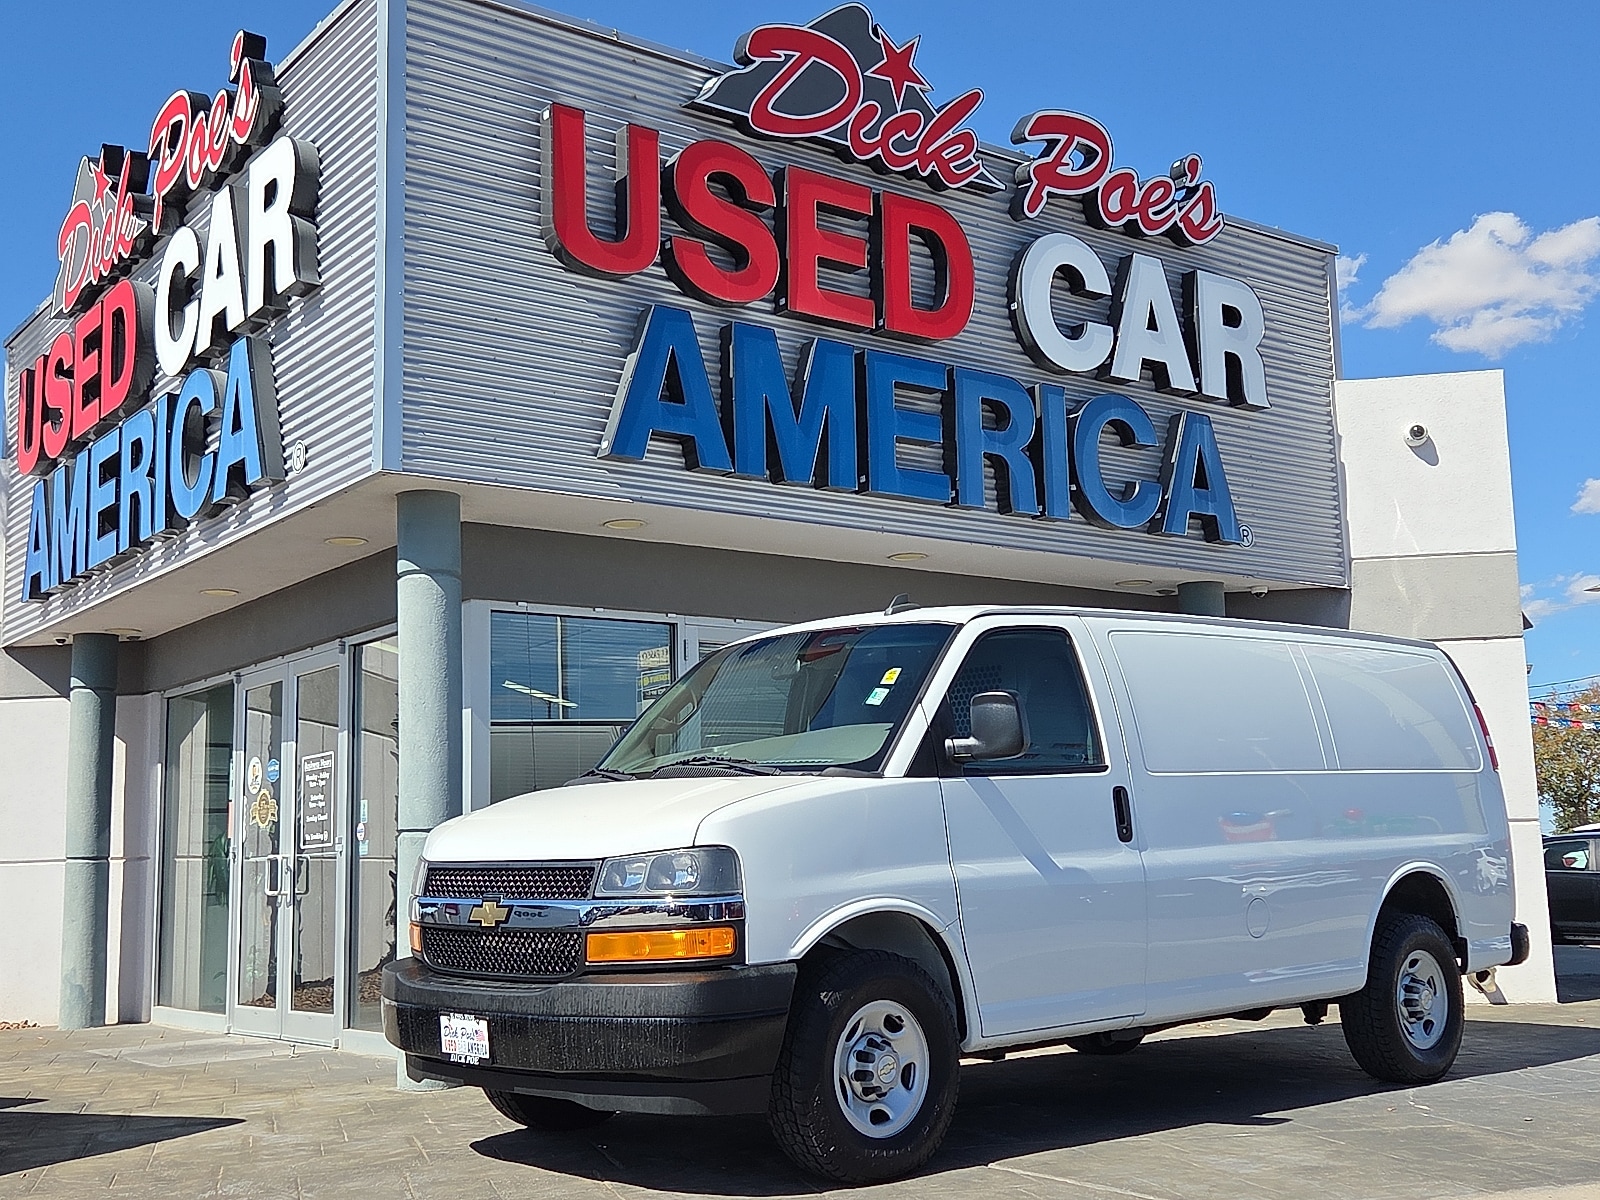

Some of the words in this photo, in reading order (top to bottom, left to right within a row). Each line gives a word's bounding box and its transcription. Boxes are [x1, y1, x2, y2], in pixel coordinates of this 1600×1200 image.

[57, 150, 137, 312] Dick
[148, 29, 262, 236] Poe's
[549, 102, 975, 343] USED
[1015, 232, 1270, 410] CAR
[745, 23, 984, 191] Dick
[1022, 108, 1224, 246] Poe's
[18, 279, 137, 476] USED
[154, 136, 298, 377] CAR
[606, 304, 1242, 546] AMERICA
[23, 336, 262, 602] AMERICA
[450, 1054, 465, 1062] DICK
[466, 1056, 479, 1065] POE
